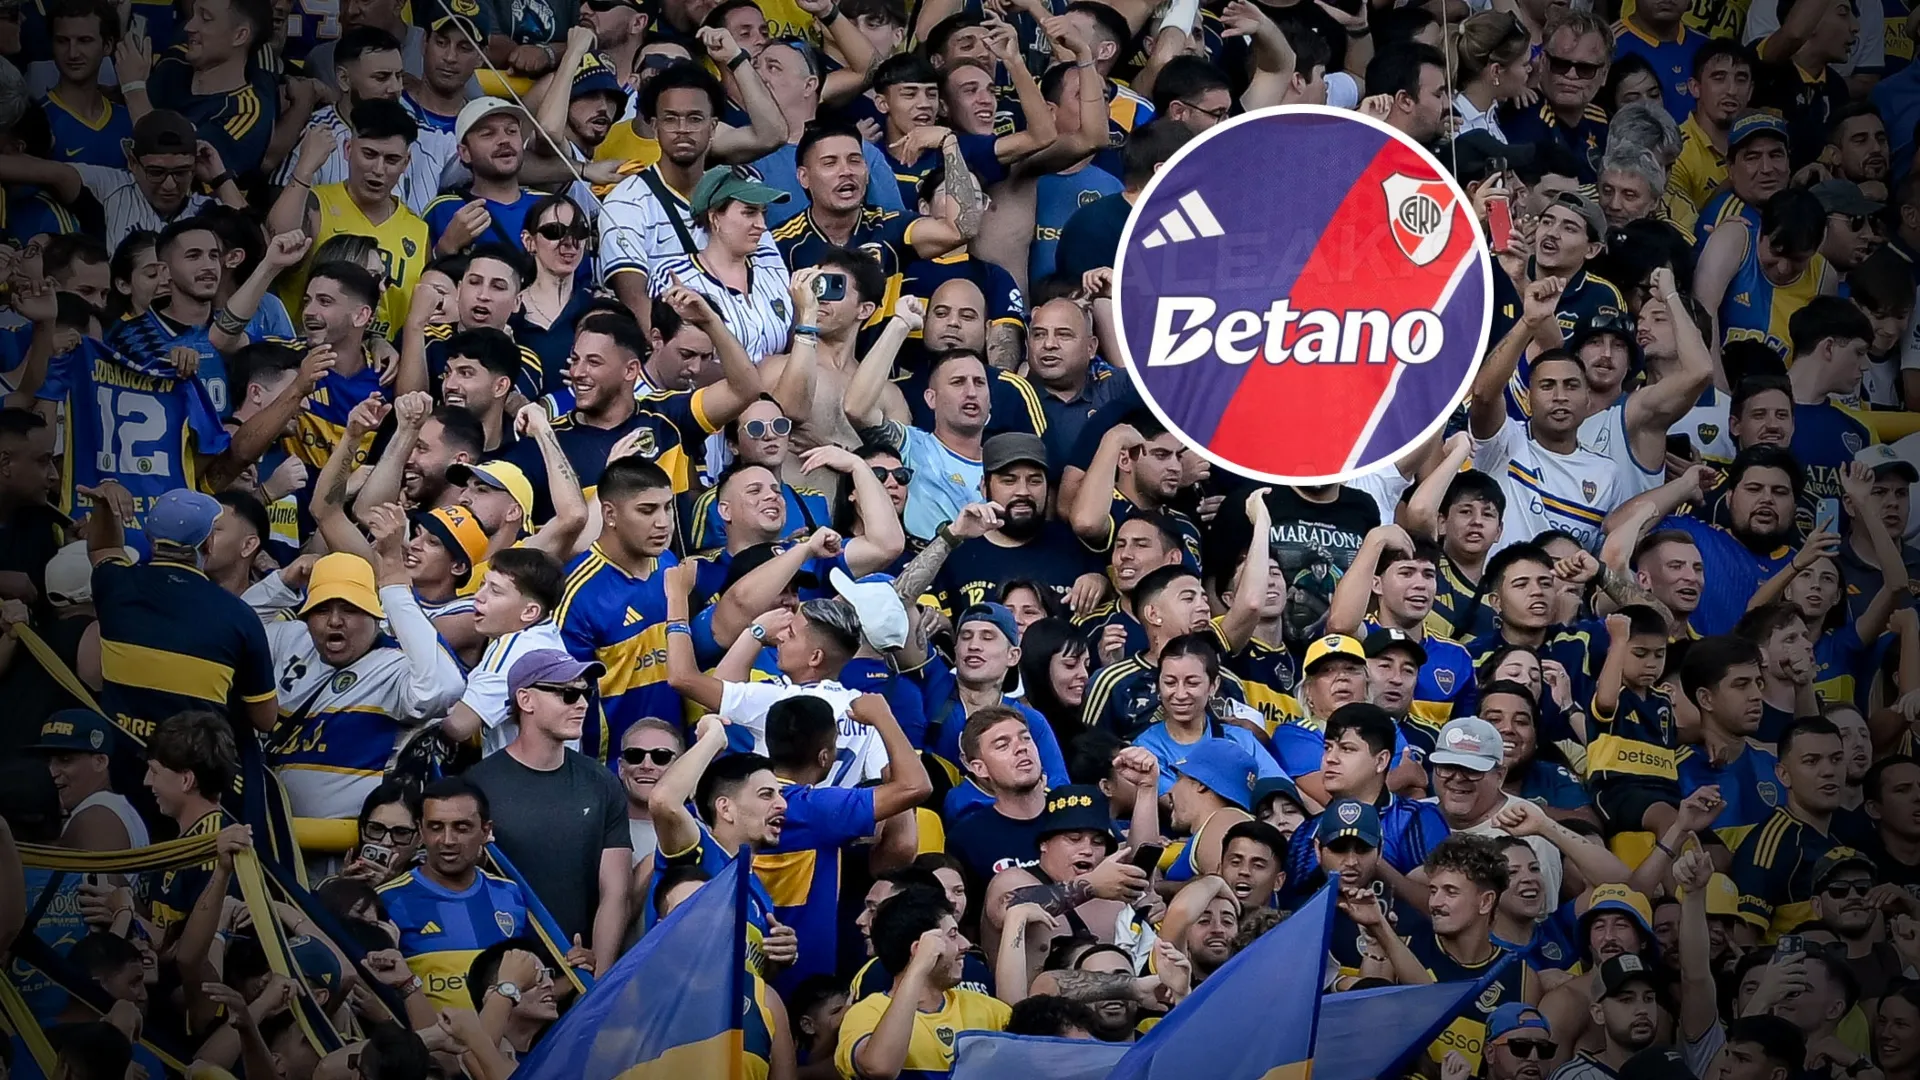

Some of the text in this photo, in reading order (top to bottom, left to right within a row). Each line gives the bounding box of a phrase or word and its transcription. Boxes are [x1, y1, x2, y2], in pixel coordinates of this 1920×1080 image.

[1147, 296, 1444, 367] Betano
[96, 385, 172, 477] 12
[1270, 524, 1363, 550] MARADONA
